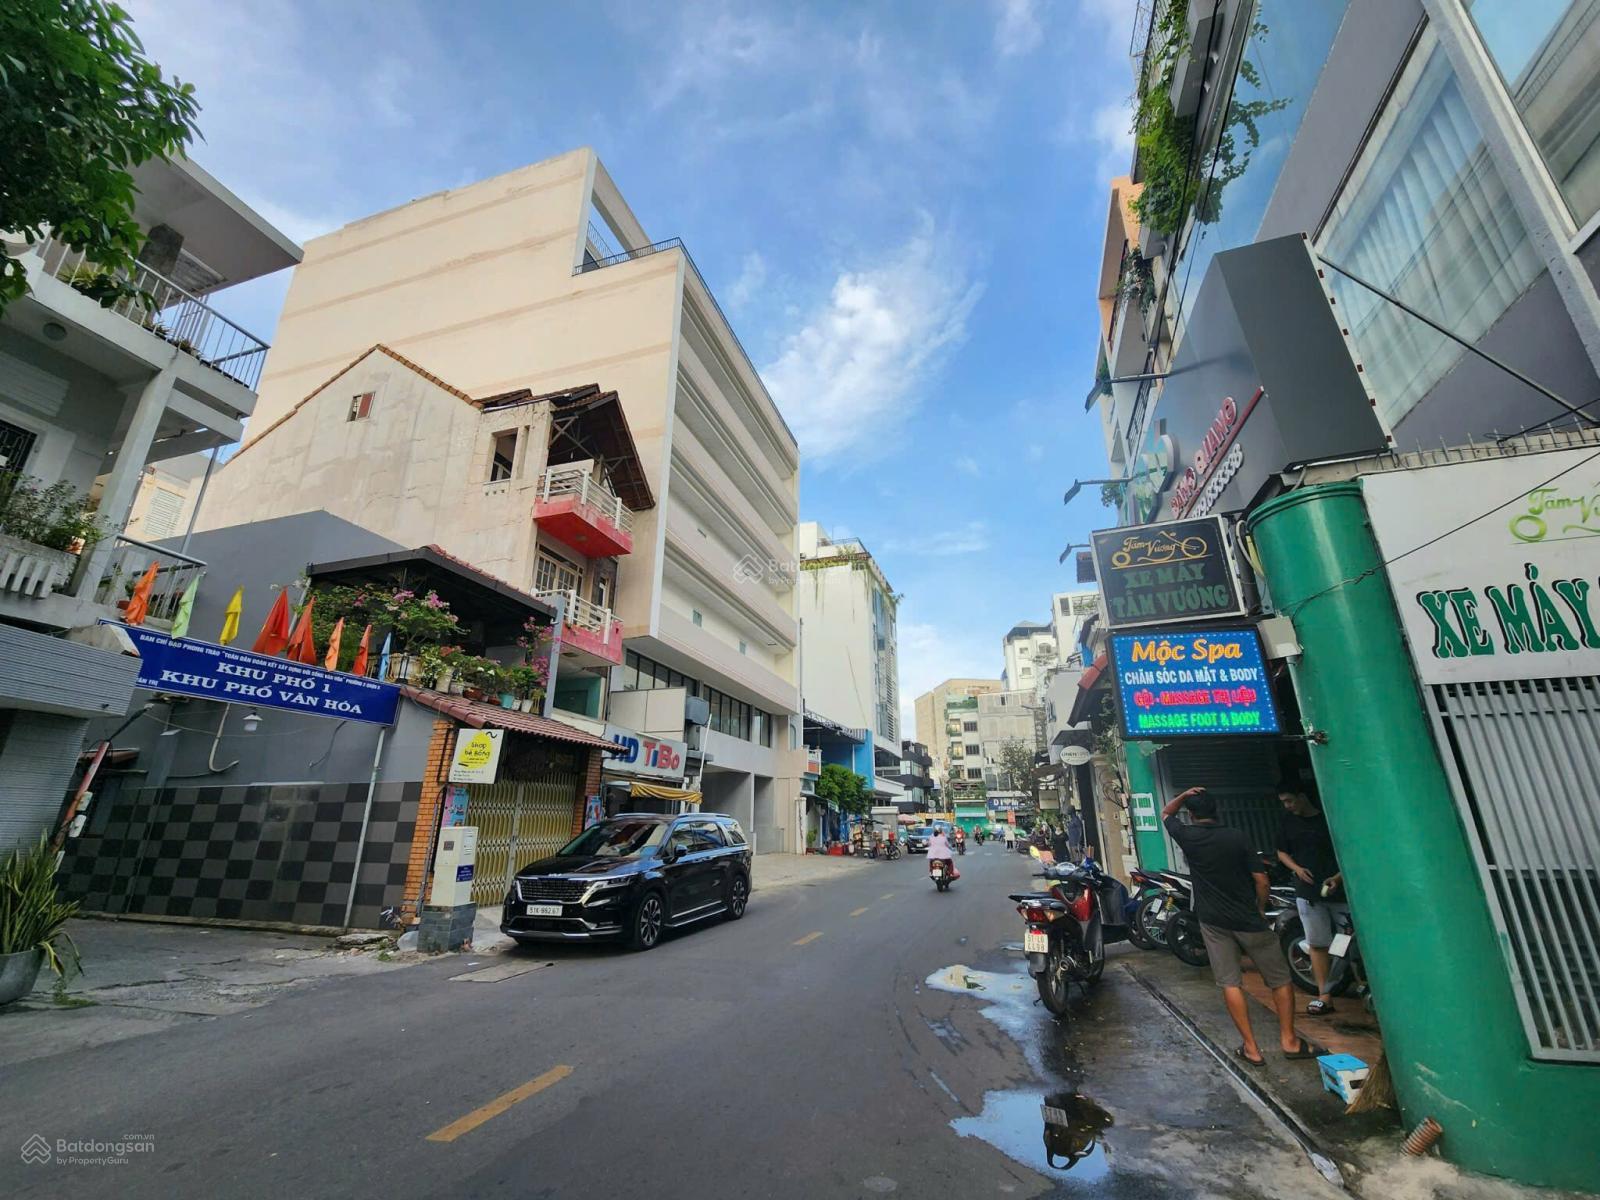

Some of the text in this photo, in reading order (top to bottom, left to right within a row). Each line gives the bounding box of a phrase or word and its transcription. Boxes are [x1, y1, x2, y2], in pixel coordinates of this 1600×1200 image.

[1123, 562, 1206, 588] XE MÁY
[1112, 584, 1229, 618] TÂM VƯƠNG
[1416, 586, 1495, 659] XE
[140, 634, 156, 642] BAN
[1132, 639, 1243, 666] Mộc Spa
[216, 662, 330, 694] KHU PHỐ 1
[1124, 666, 1258, 686] CHĂM SÓC DA MẶT & BODY
[160, 670, 362, 714] KHU PHỐ VĂN HÓA
[1160, 690, 1211, 706] MASSAGE
[1138, 711, 1260, 729] MASSAGE FOOT & BODY
